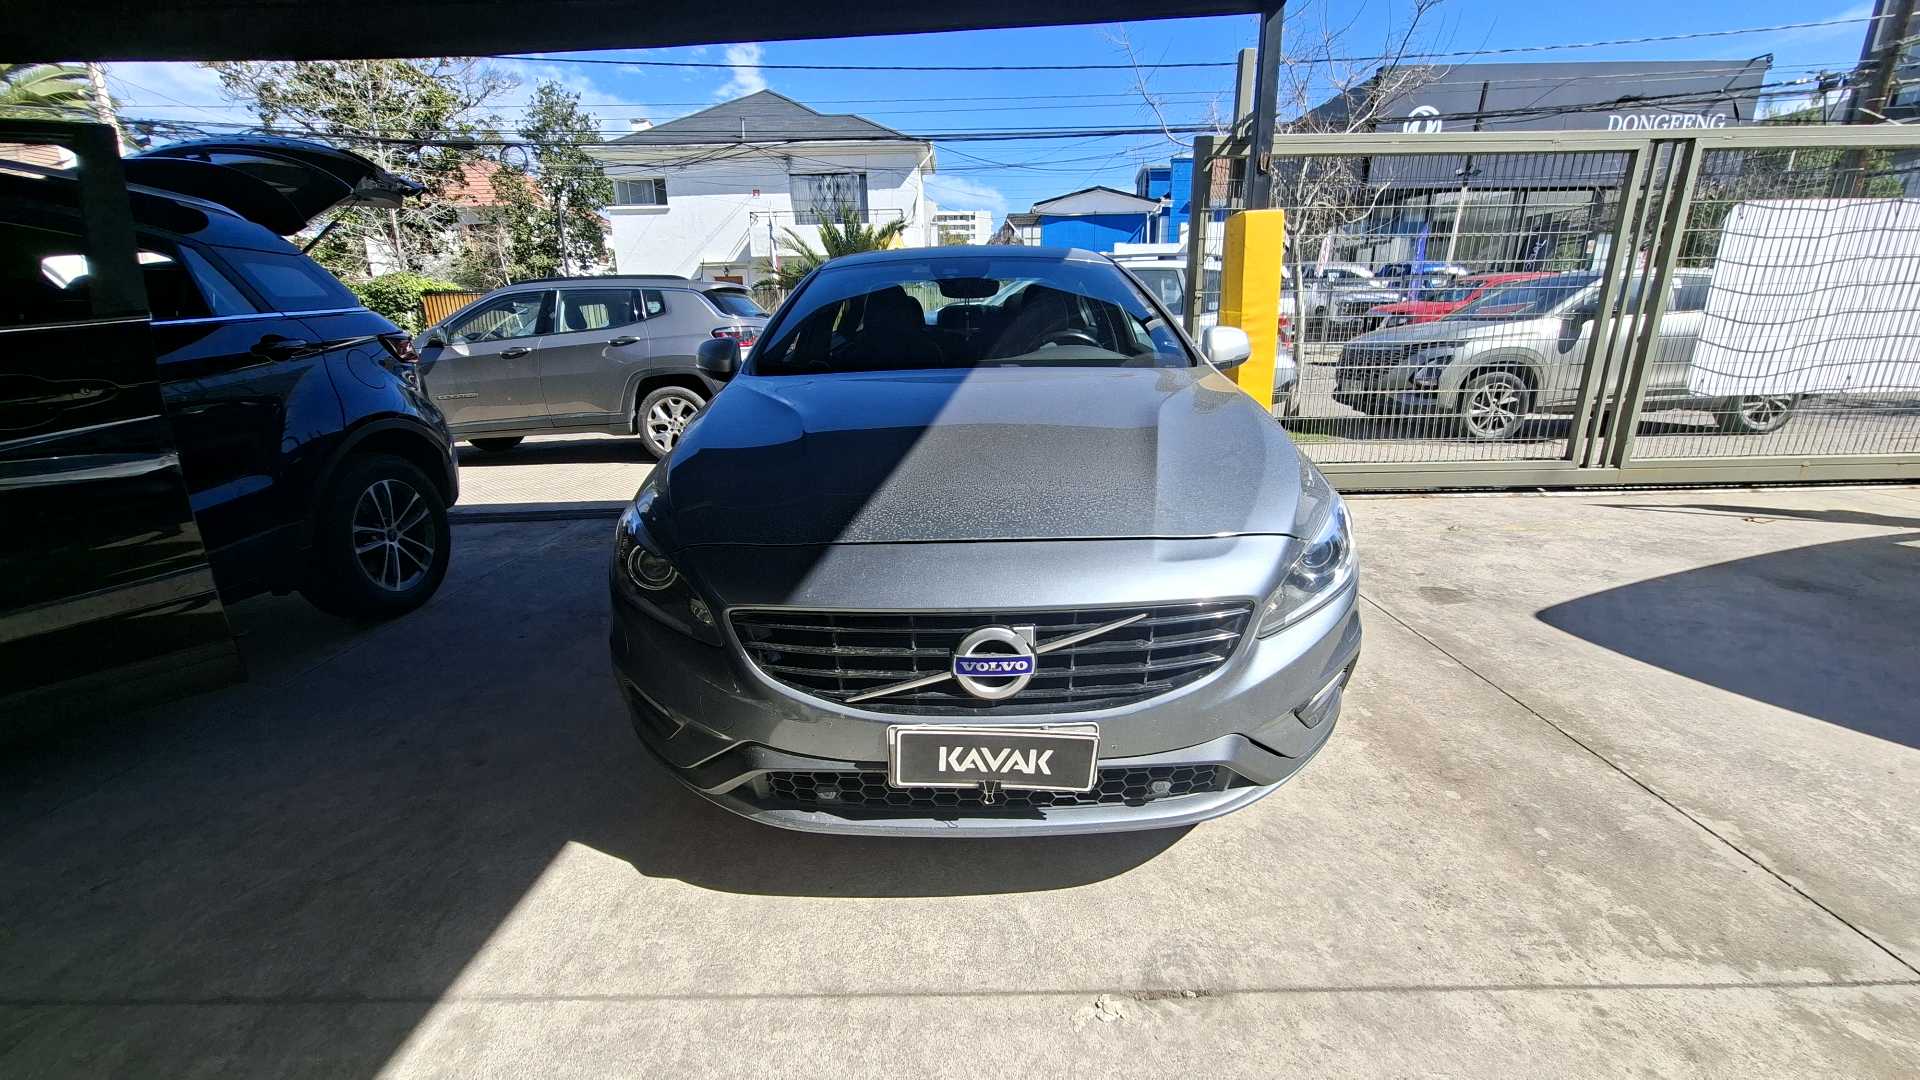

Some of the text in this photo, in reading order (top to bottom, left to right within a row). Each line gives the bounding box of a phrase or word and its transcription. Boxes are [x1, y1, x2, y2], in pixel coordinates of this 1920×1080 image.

[1607, 113, 1726, 131] DONGFENG
[960, 660, 1028, 672] VOLVO
[938, 746, 1054, 775] KAVAK
